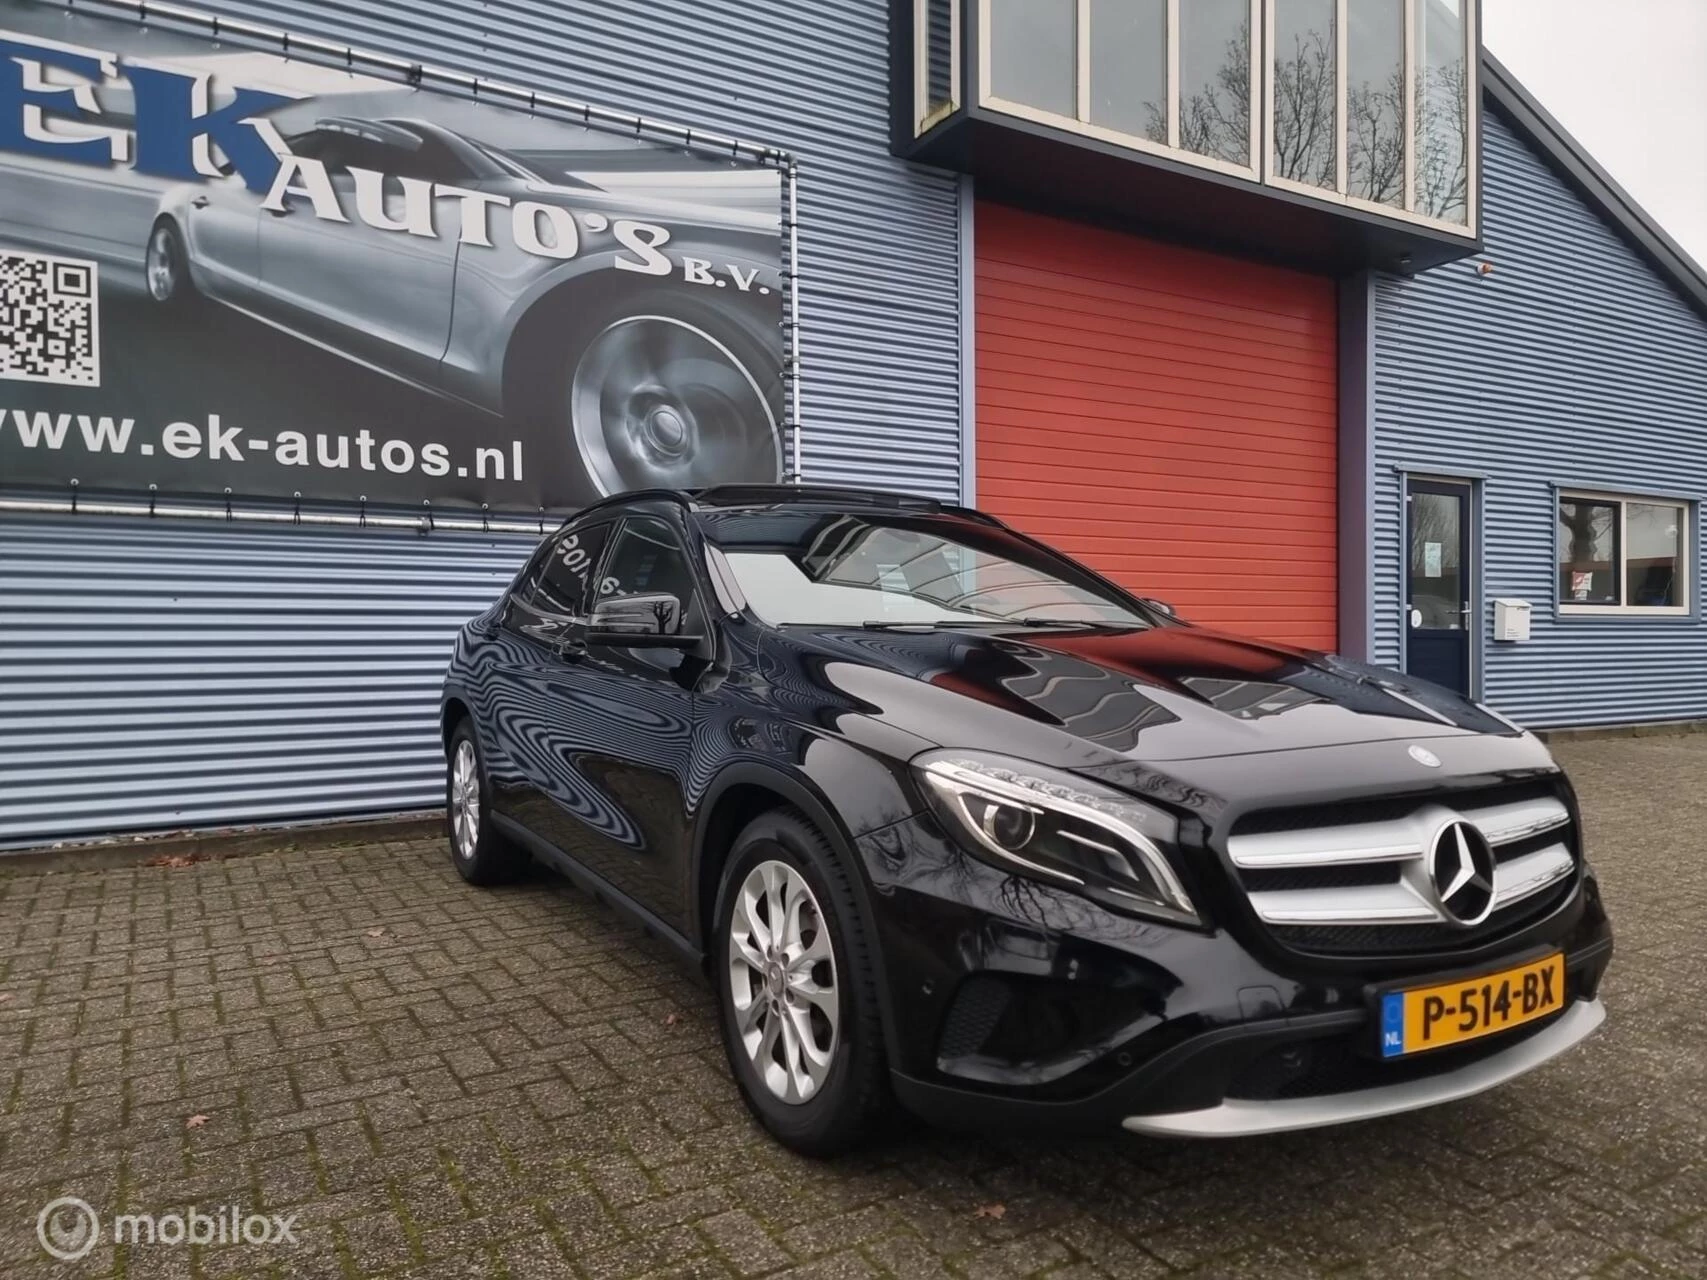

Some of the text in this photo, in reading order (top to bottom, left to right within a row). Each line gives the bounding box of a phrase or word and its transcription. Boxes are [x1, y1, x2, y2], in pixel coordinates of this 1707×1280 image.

[0, 30, 314, 196] EK
[682, 256, 770, 294] B.V.
[0, 409, 523, 481] ww.ek-autos.nl
[1385, 1032, 1401, 1047] NL
[1423, 966, 1554, 1040] P-514-BX
